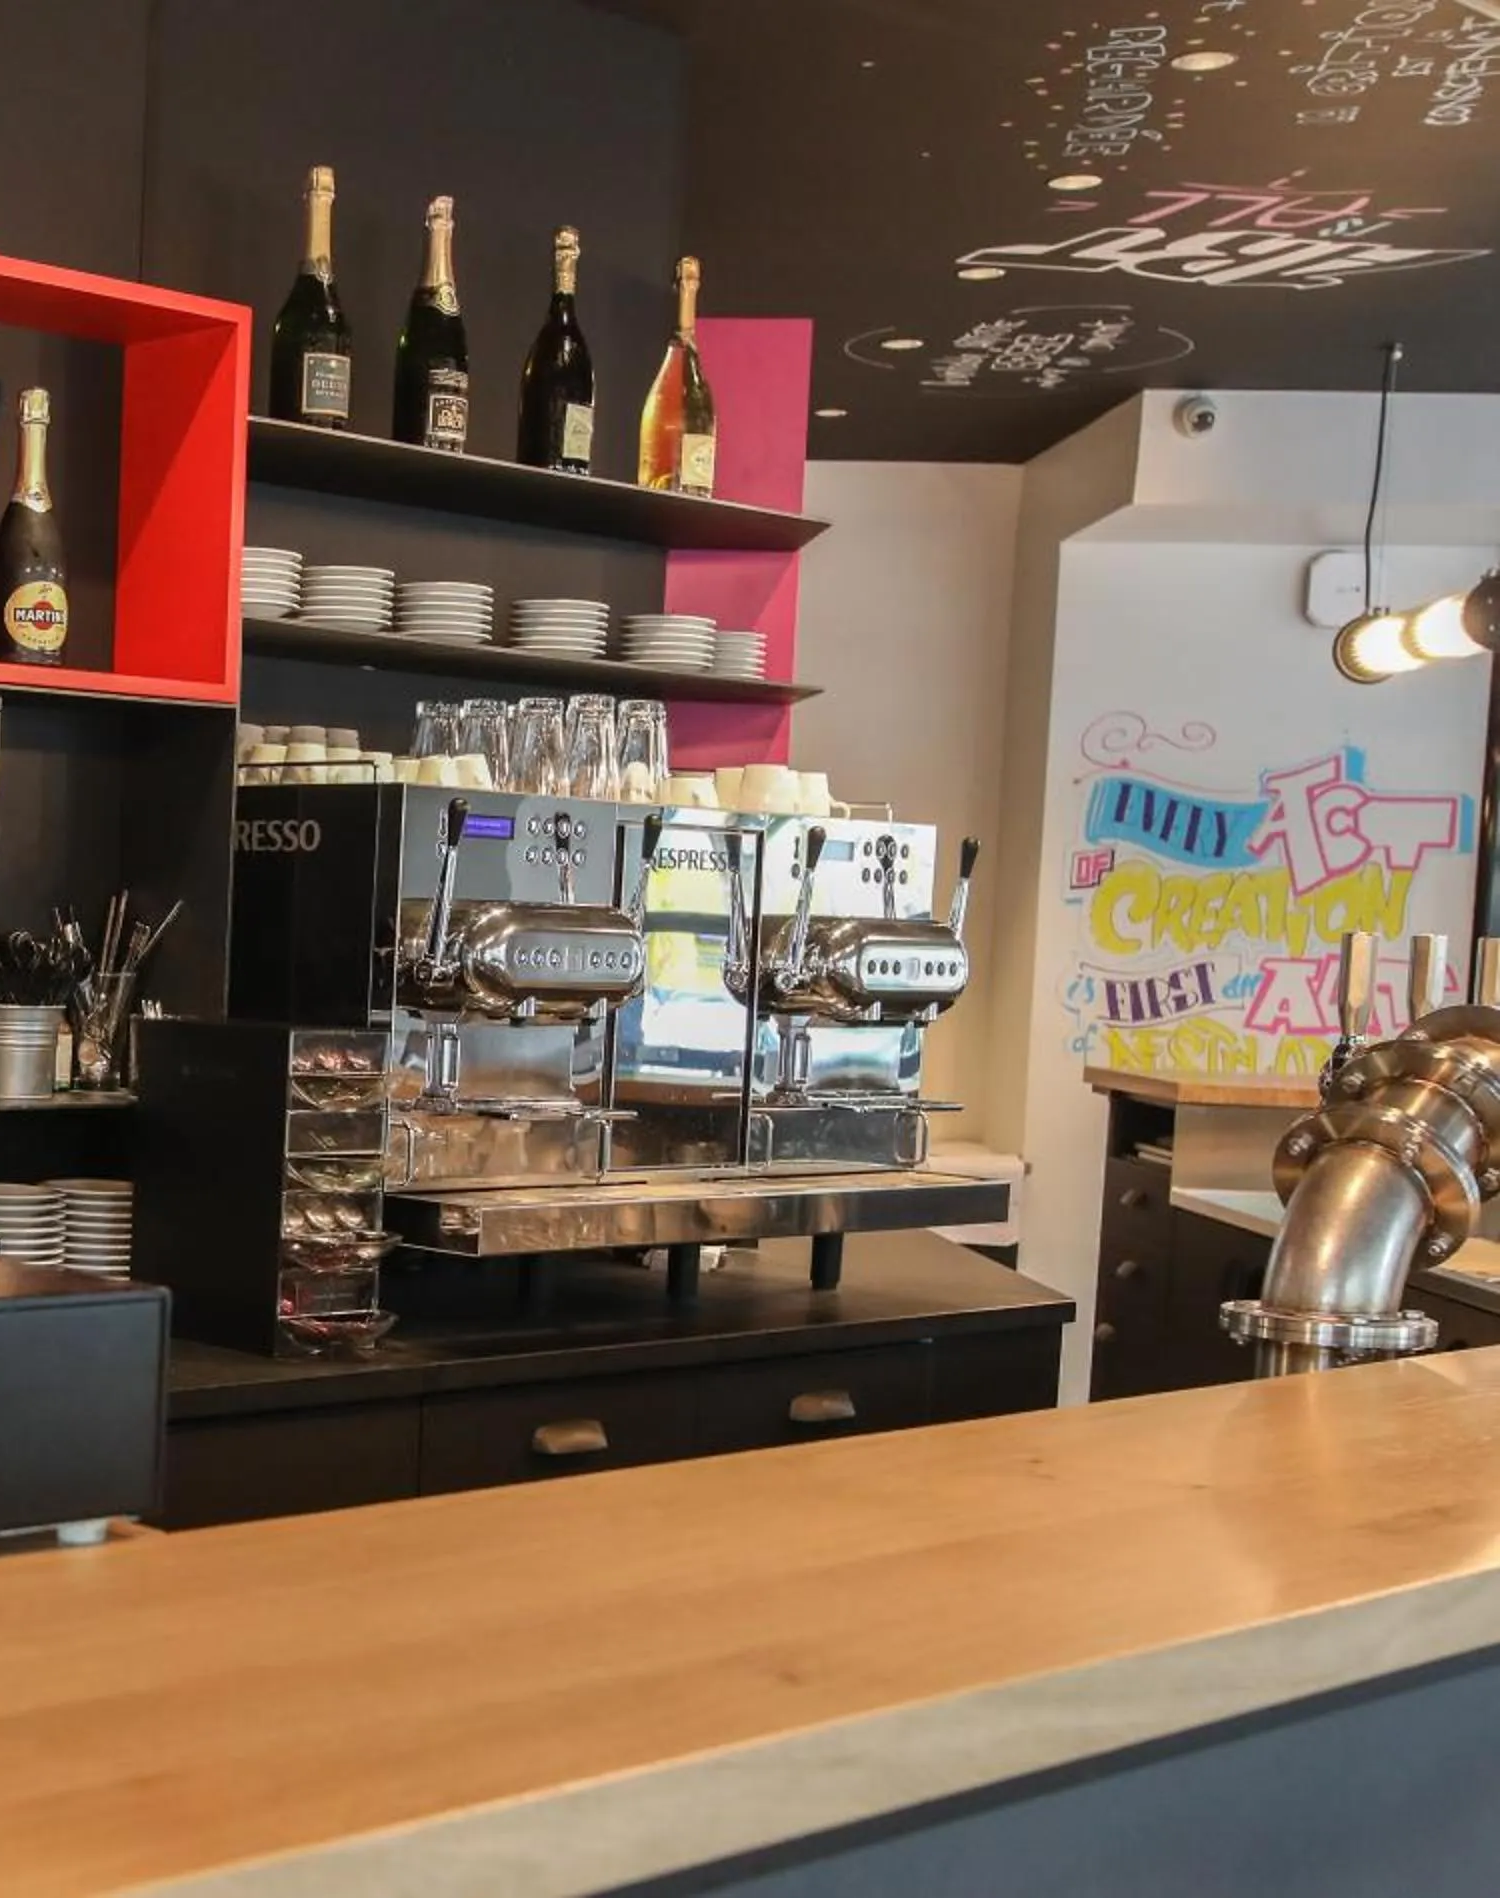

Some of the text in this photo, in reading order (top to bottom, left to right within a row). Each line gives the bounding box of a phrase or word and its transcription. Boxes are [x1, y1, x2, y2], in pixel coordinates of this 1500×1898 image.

[1248, 750, 1464, 897] ACT
[650, 846, 736, 875] NESPRESS
[1072, 850, 1113, 888] OF
[1088, 858, 1412, 959] CREATION
[1102, 959, 1216, 1023] FIRST
